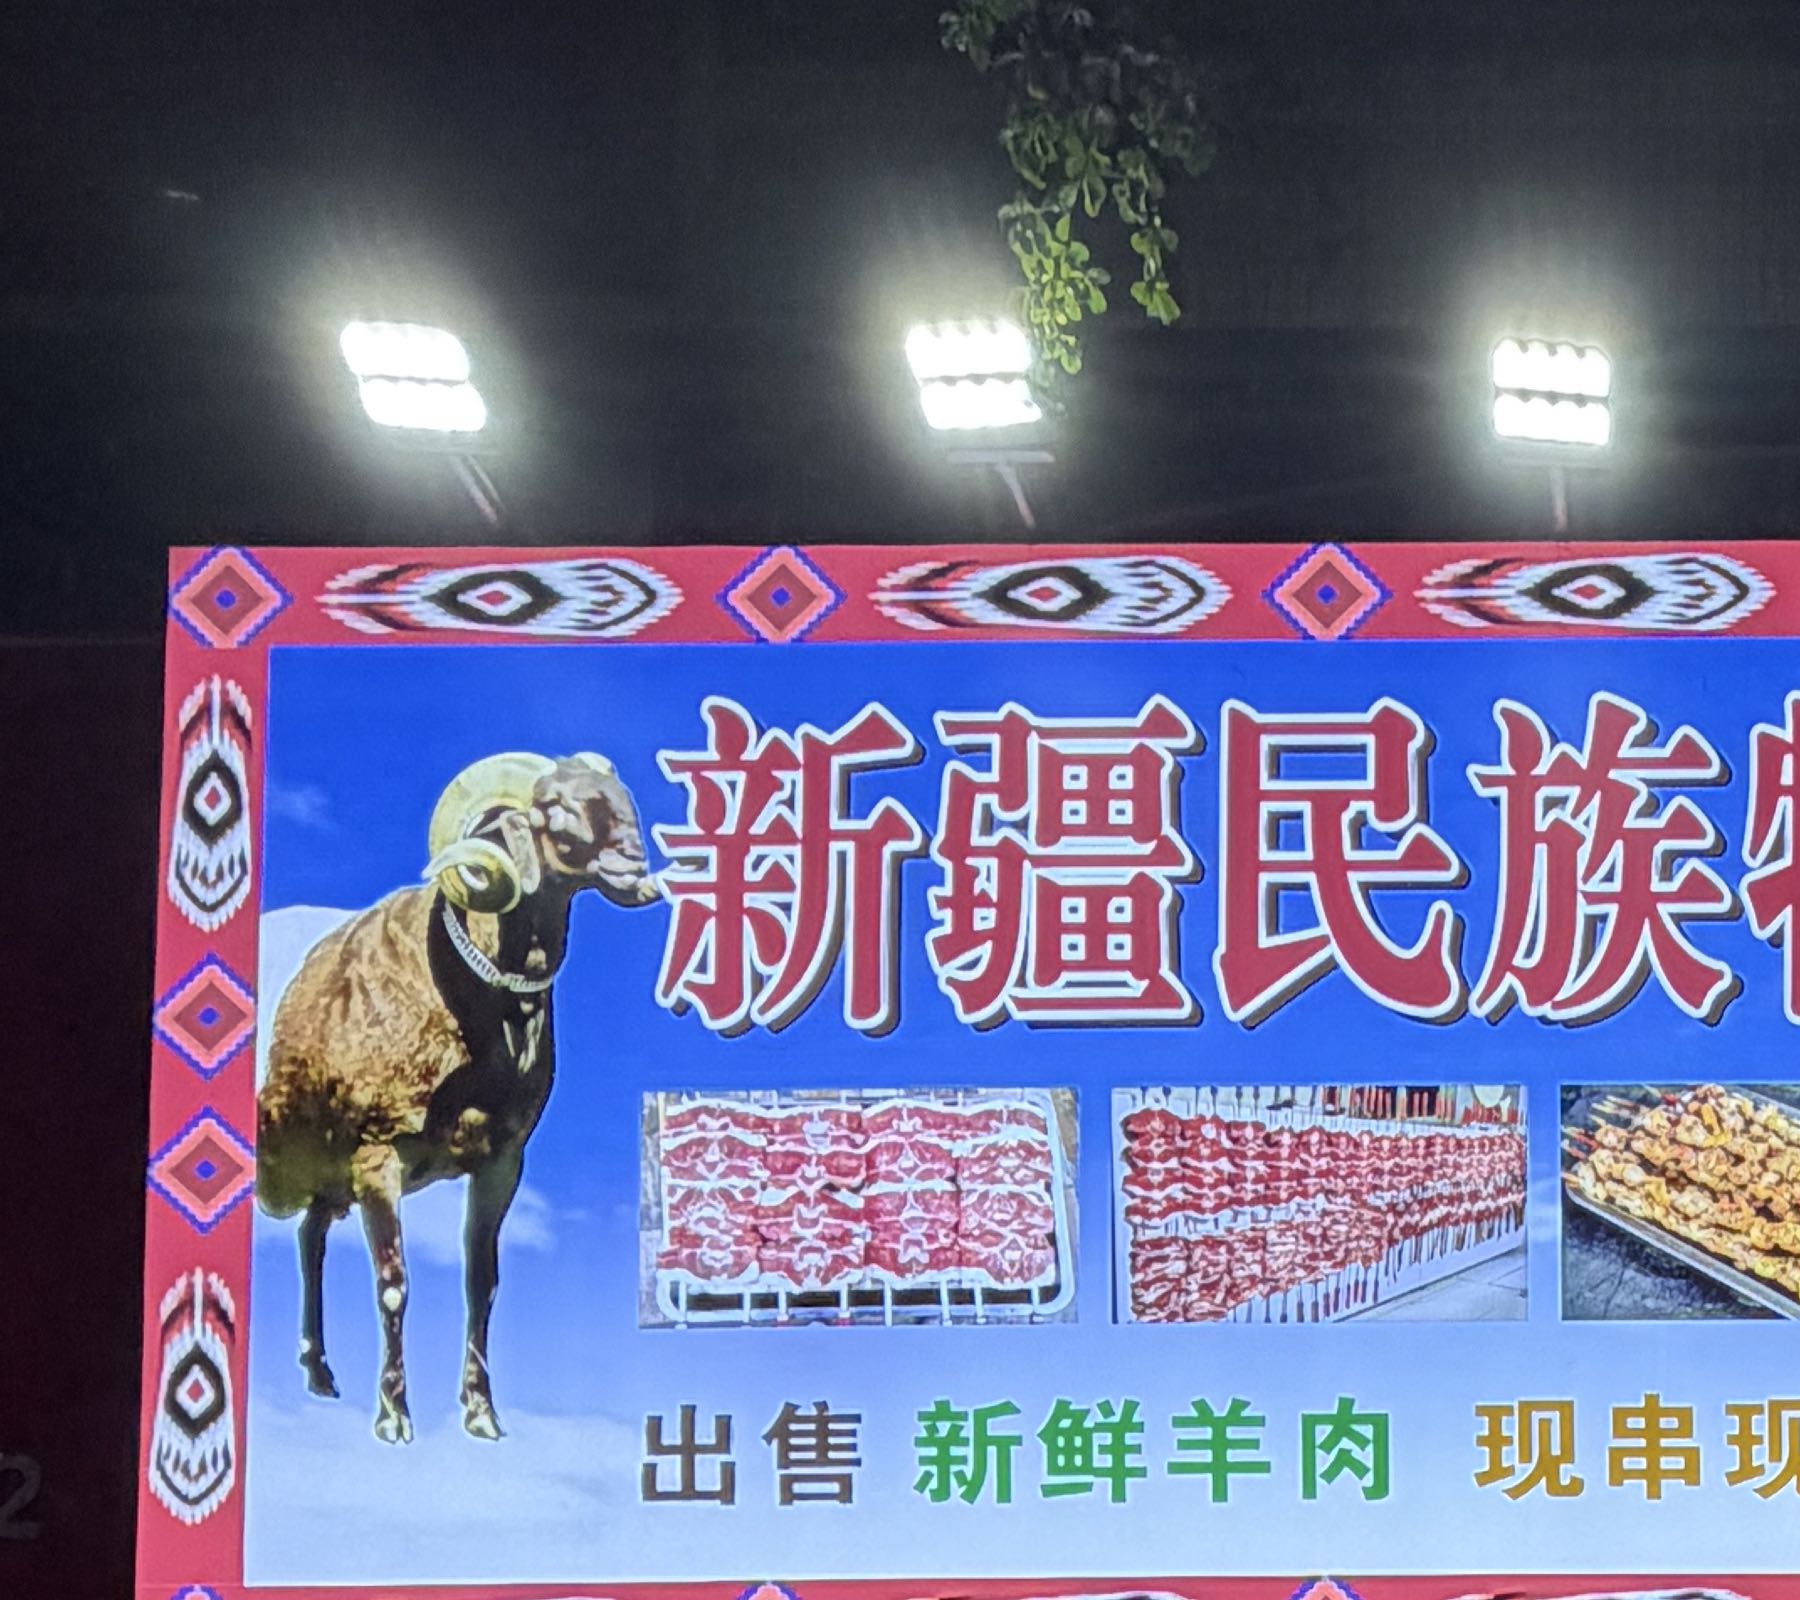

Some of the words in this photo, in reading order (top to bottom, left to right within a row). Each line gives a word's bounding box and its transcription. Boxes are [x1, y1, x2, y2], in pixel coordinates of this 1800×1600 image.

[640, 1402, 865, 1507] 出售
[913, 1396, 1392, 1504] 新鲜羊肉
